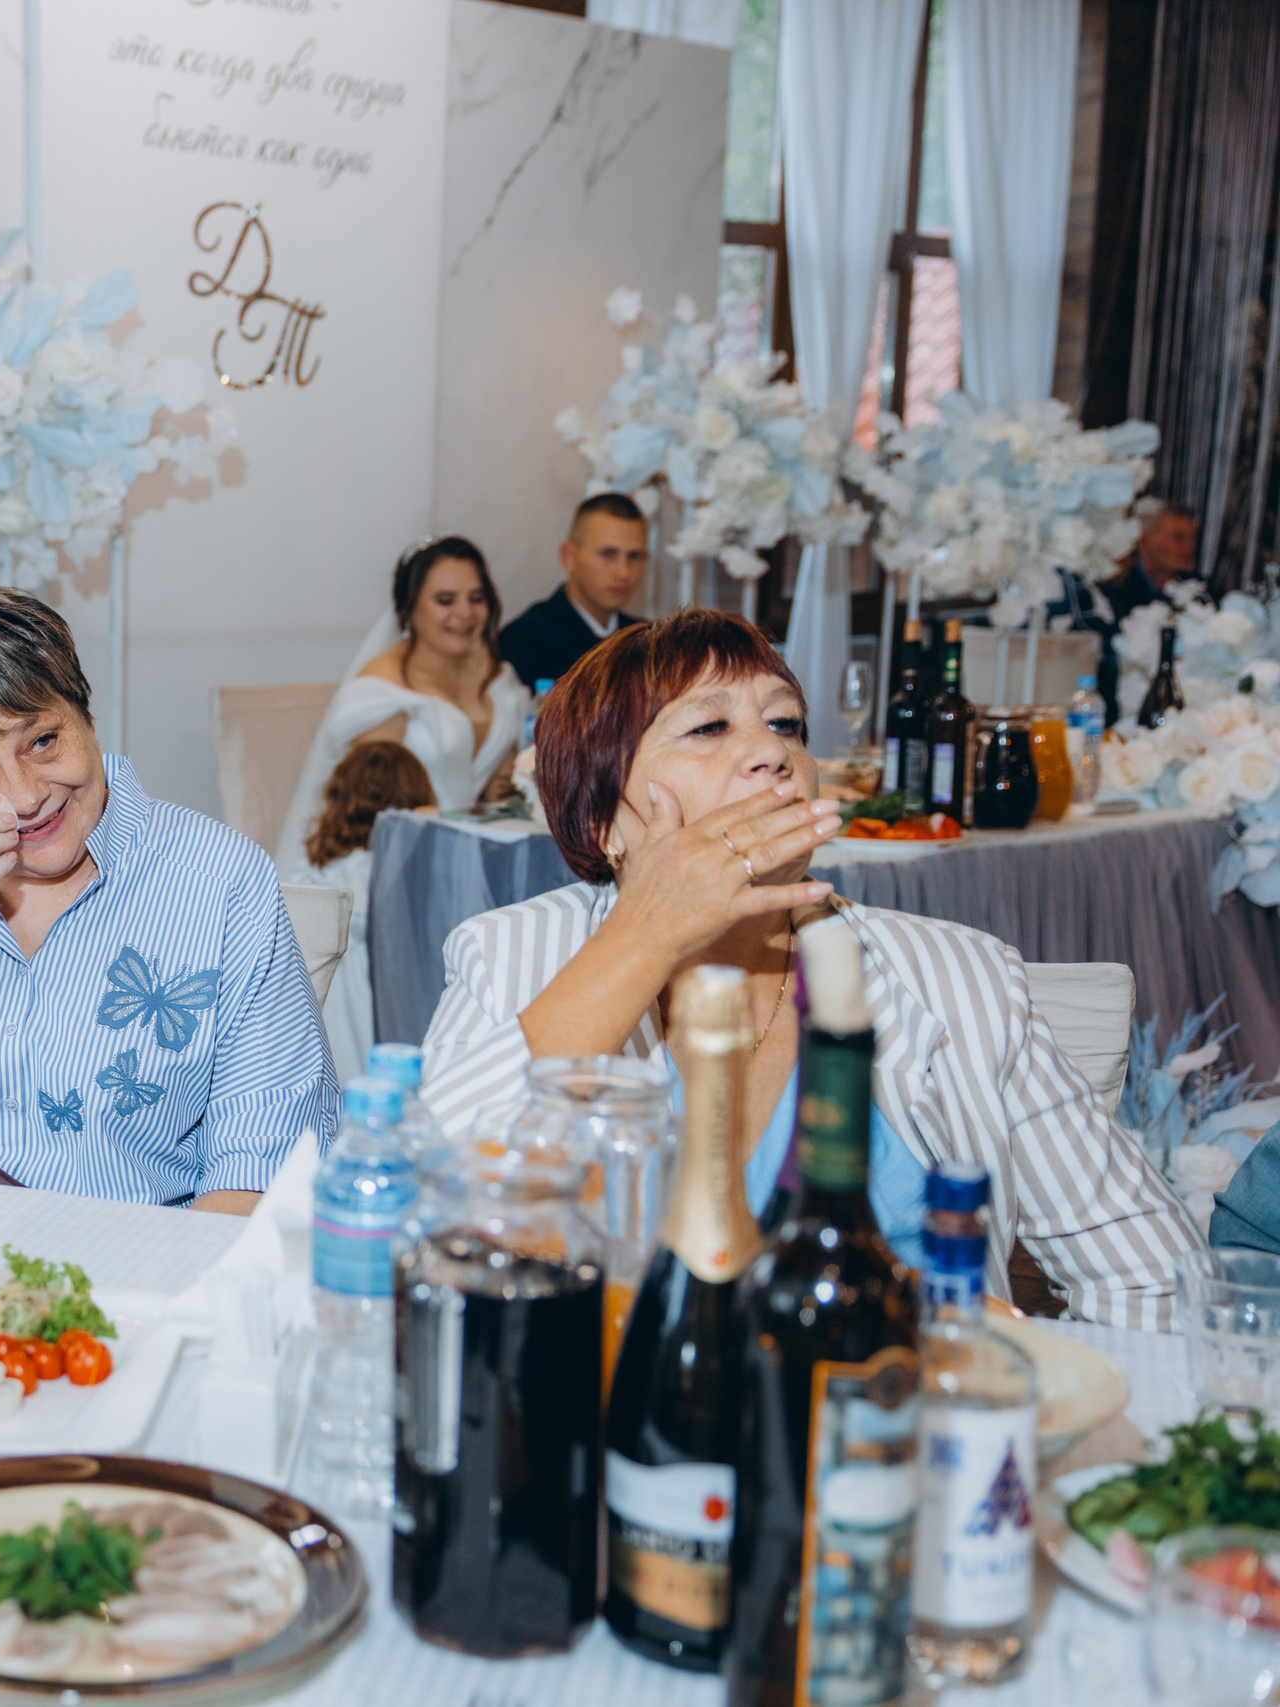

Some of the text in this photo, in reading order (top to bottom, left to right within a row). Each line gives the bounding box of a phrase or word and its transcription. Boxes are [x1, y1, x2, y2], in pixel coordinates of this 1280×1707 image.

[107, 33, 165, 67] это
[173, 48, 256, 99] когда
[256, 37, 318, 106] два
[255, 137, 307, 168] как
